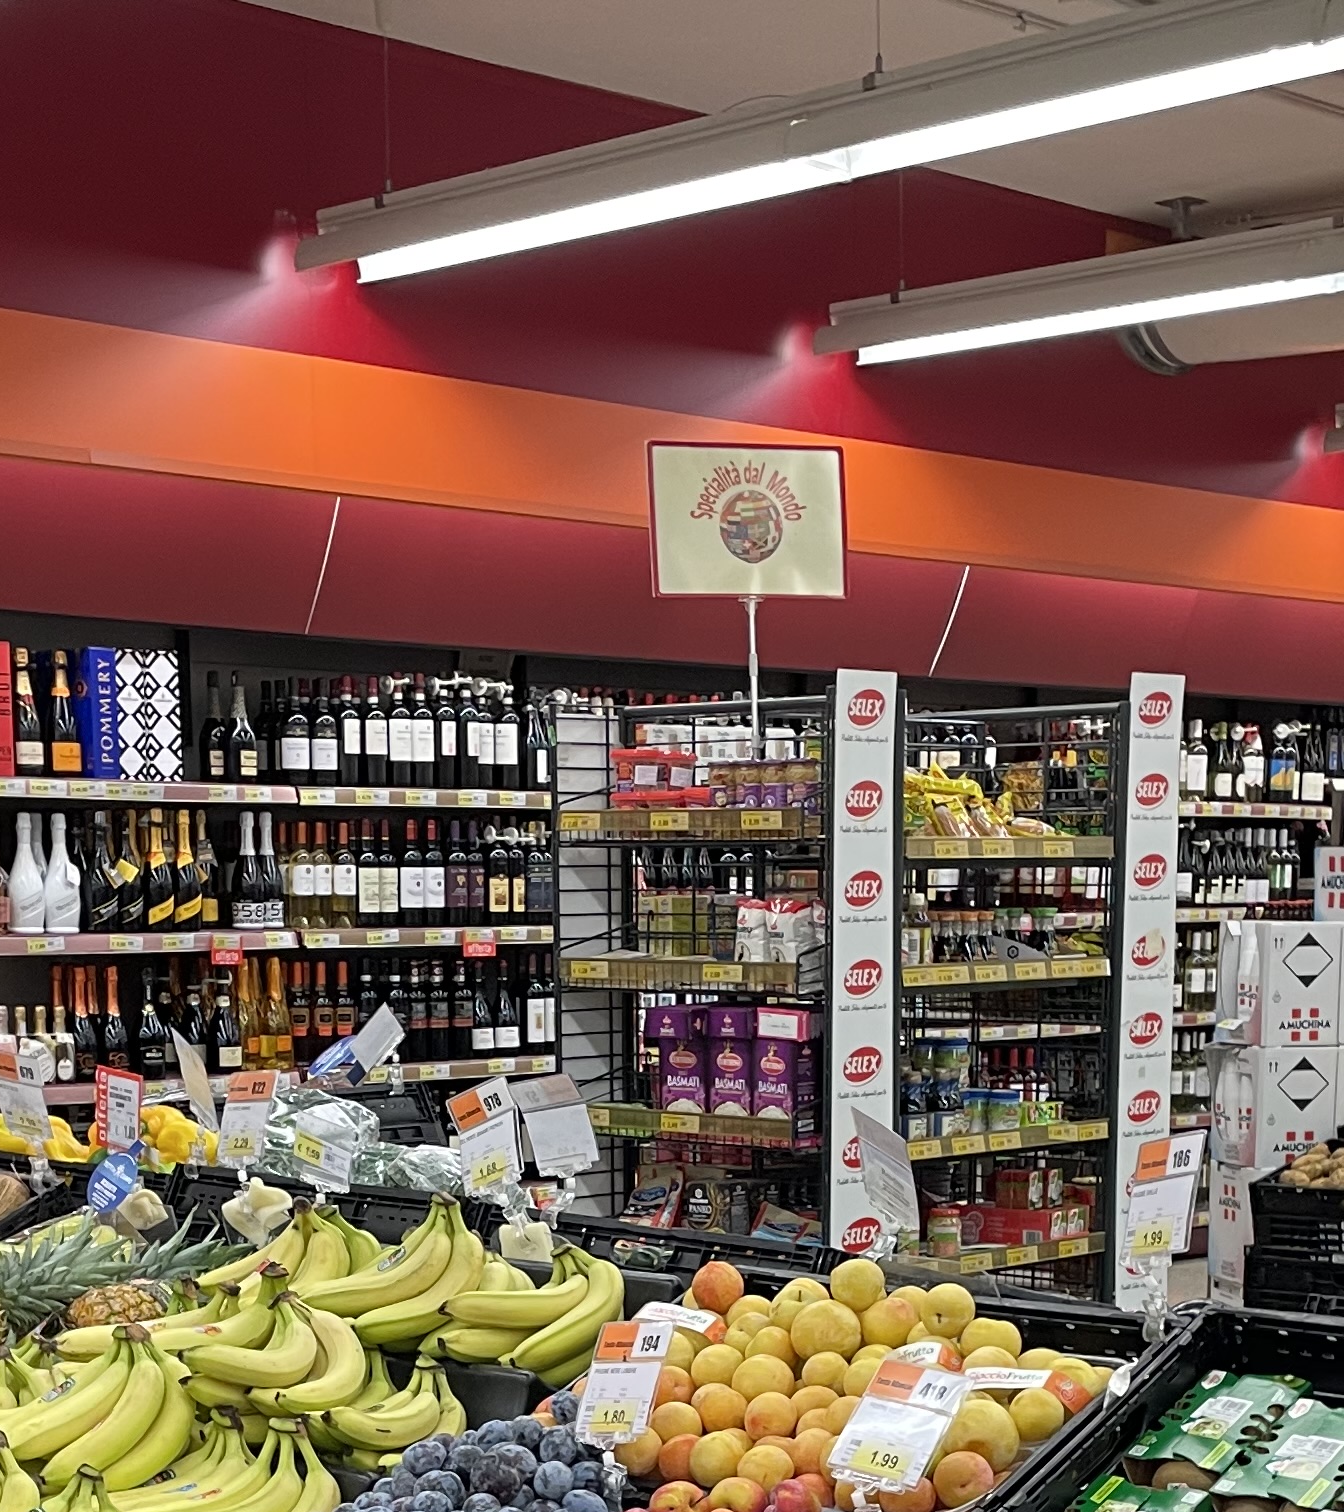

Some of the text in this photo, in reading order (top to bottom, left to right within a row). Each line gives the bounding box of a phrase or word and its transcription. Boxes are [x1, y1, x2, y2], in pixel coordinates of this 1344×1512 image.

[690, 460, 807, 521] Specialità dal Mondo
[98, 658, 114, 765] POMMERY
[849, 698, 885, 719] SELEX
[1139, 699, 1172, 717] SELEX
[847, 790, 882, 810] SELEX
[1136, 781, 1168, 799] SELEX
[1134, 861, 1165, 879] SELEX
[846, 880, 881, 899] SELEX
[845, 968, 880, 988] SELEX
[1279, 1020, 1330, 1029] AMUCHINA
[844, 1055, 880, 1076] SELEX
[667, 1075, 700, 1088] BASMATI
[715, 1078, 745, 1091] BASMATI
[758, 1082, 788, 1094] BASMATI
[99, 1071, 108, 1142] offerta
[484, 1092, 502, 1112] 978
[1129, 1098, 1161, 1117] SELEX
[1172, 1149, 1192, 1169] 186
[843, 1224, 879, 1245] SELEX
[641, 1335, 661, 1352] 194
[870, 1450, 900, 1470] 1,99
